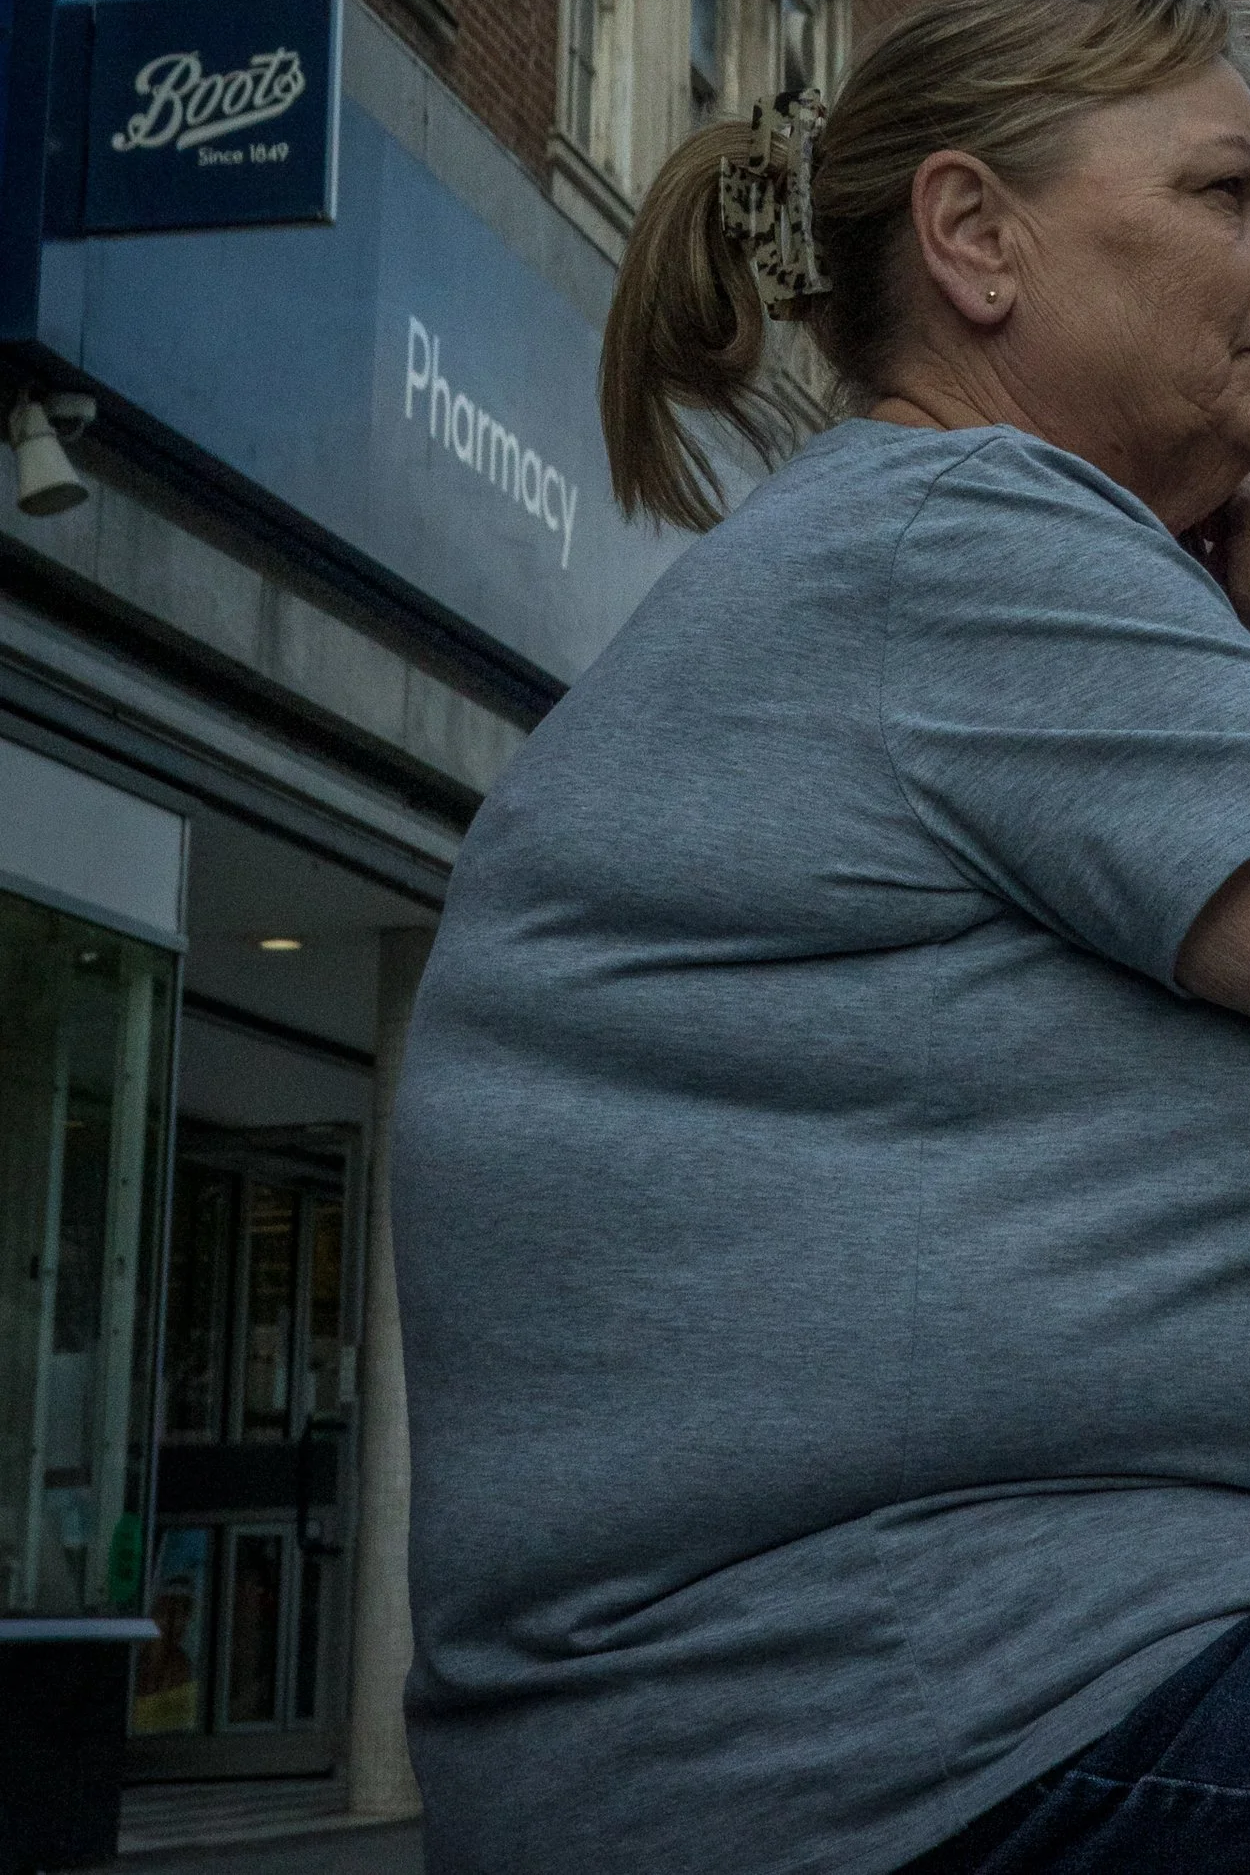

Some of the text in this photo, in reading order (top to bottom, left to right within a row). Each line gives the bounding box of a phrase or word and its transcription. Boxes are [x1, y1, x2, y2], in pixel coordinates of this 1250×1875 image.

[111, 46, 306, 152] Boots
[197, 141, 290, 167] Since 1849
[404, 315, 579, 570] Pharmacy
